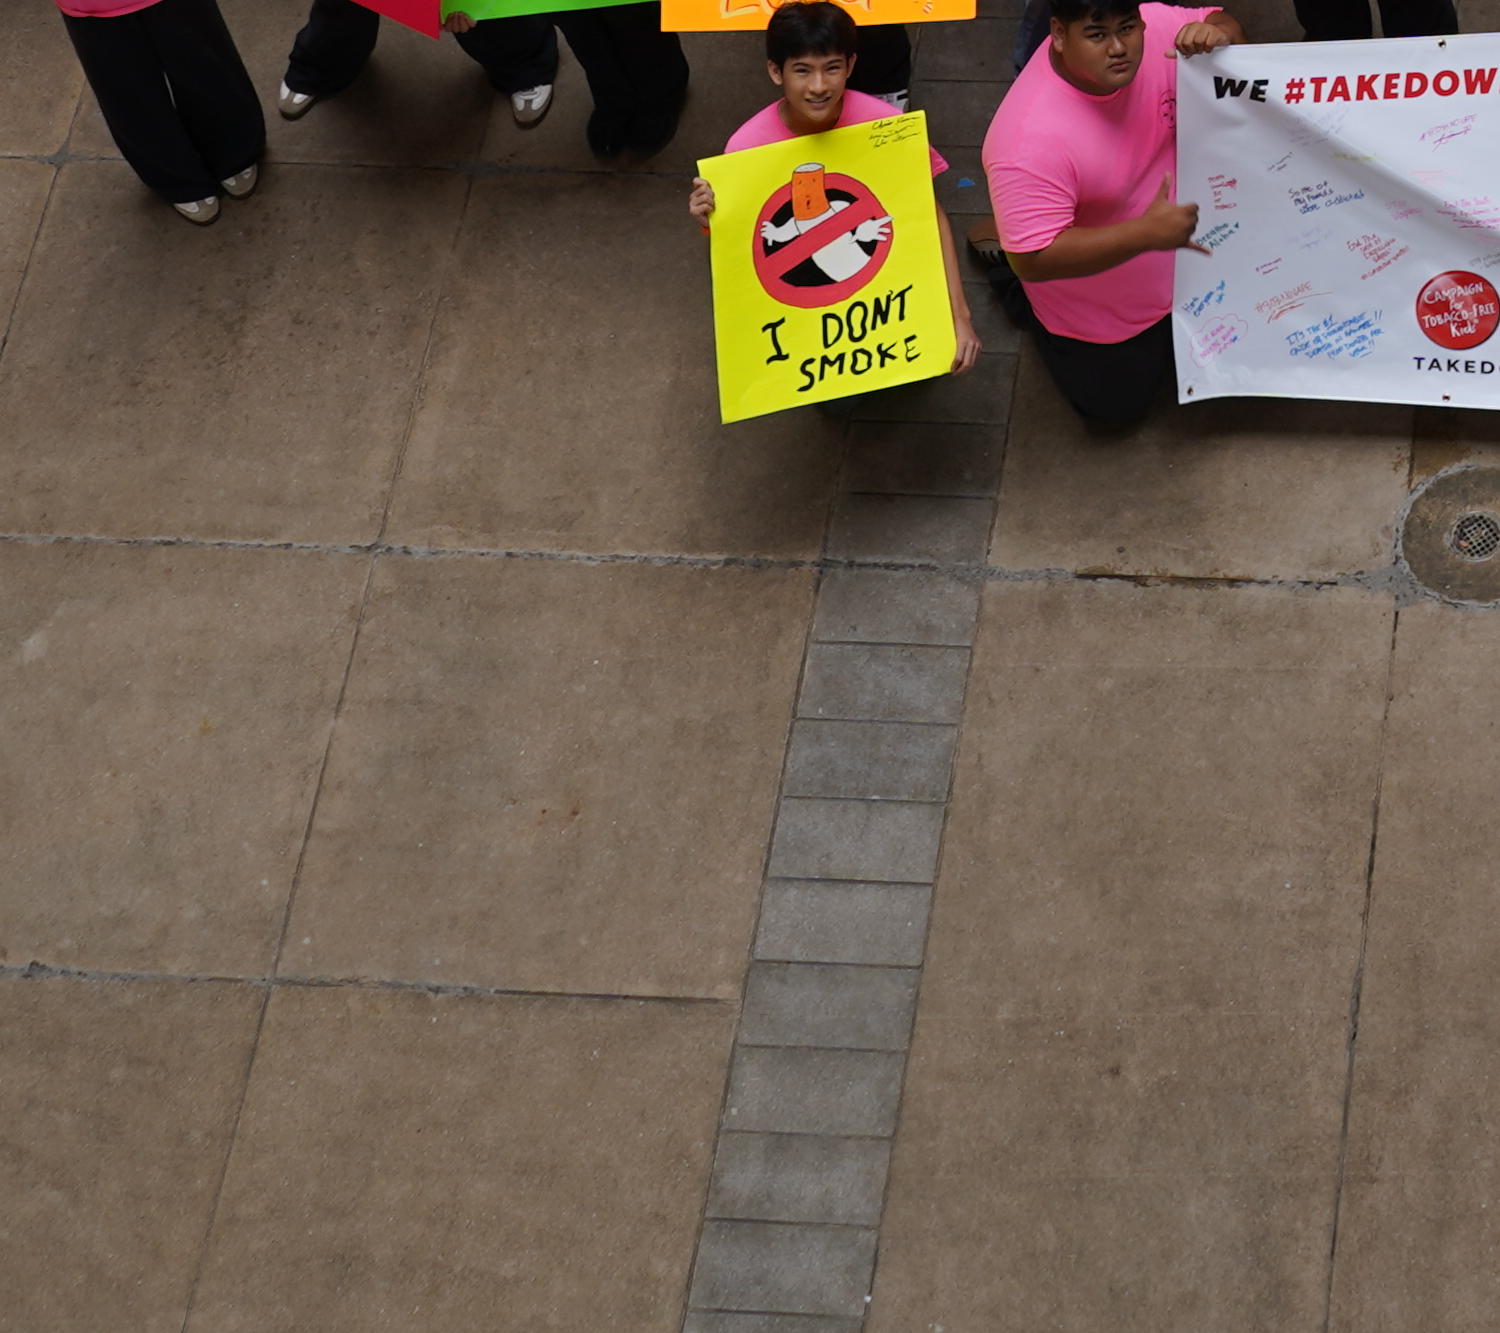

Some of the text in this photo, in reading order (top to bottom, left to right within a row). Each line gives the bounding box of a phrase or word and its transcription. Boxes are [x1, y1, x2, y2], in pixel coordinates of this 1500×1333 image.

[1213, 75, 1269, 104] WE
[1423, 282, 1484, 304] CAMPAIGN
[797, 334, 921, 393] SMOKE
